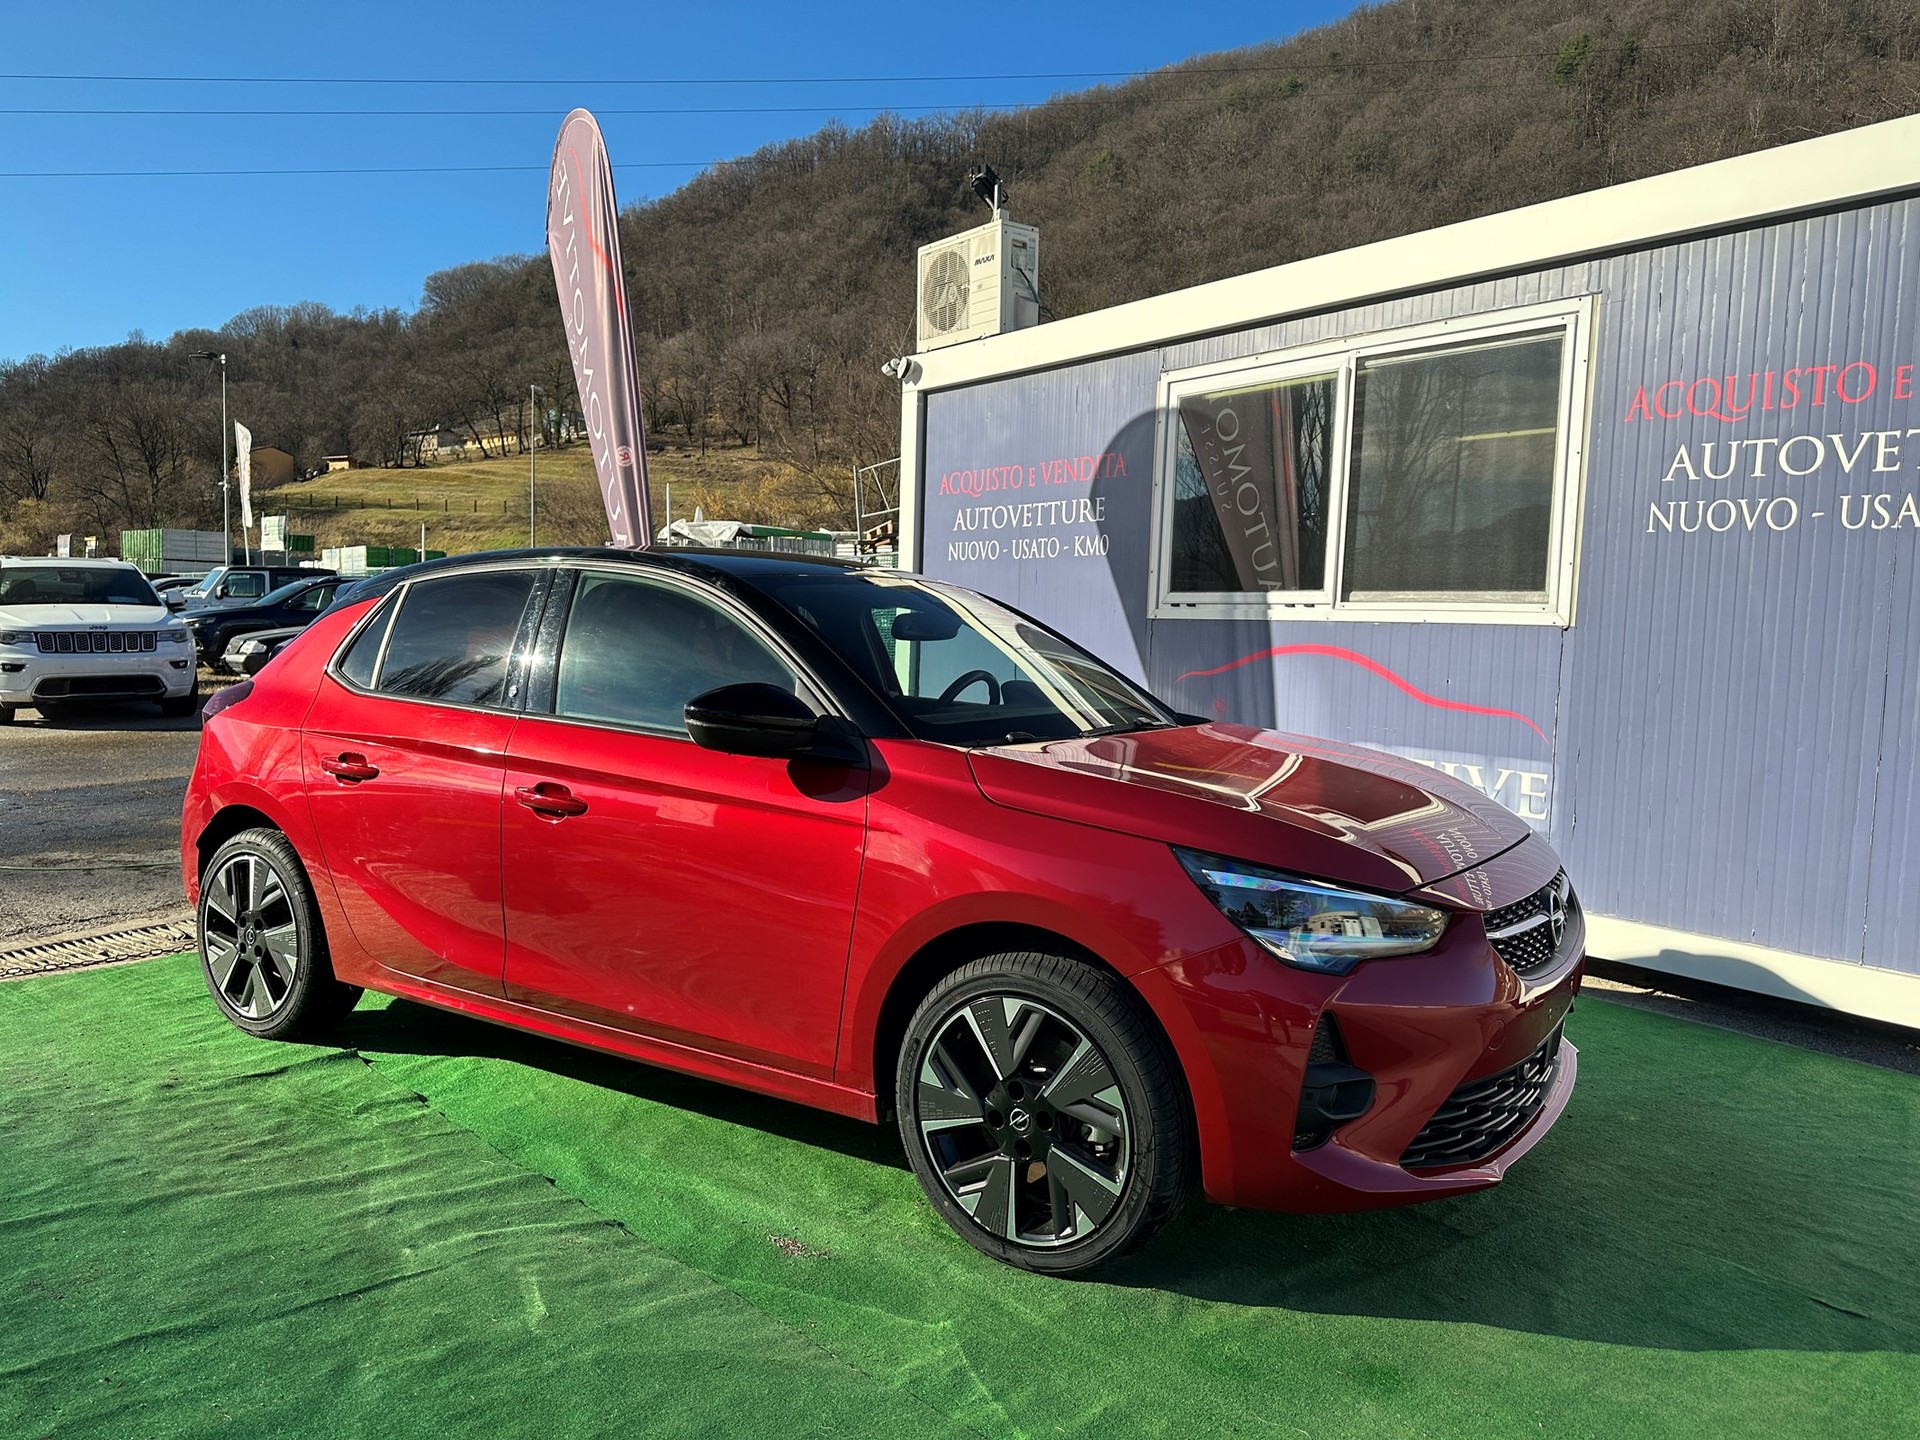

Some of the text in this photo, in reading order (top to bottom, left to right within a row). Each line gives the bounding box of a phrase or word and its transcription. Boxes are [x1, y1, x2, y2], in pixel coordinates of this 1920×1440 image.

[1624, 361, 1877, 422] ACQUISTO
[939, 464, 1023, 497] ACQUISTO
[1040, 452, 1127, 485] VENDITA
[953, 497, 1106, 531] AUTOVETTURE
[1646, 497, 1798, 532] NUOVO
[948, 540, 1000, 561] NUOVO
[1011, 537, 1060, 560] USATO
